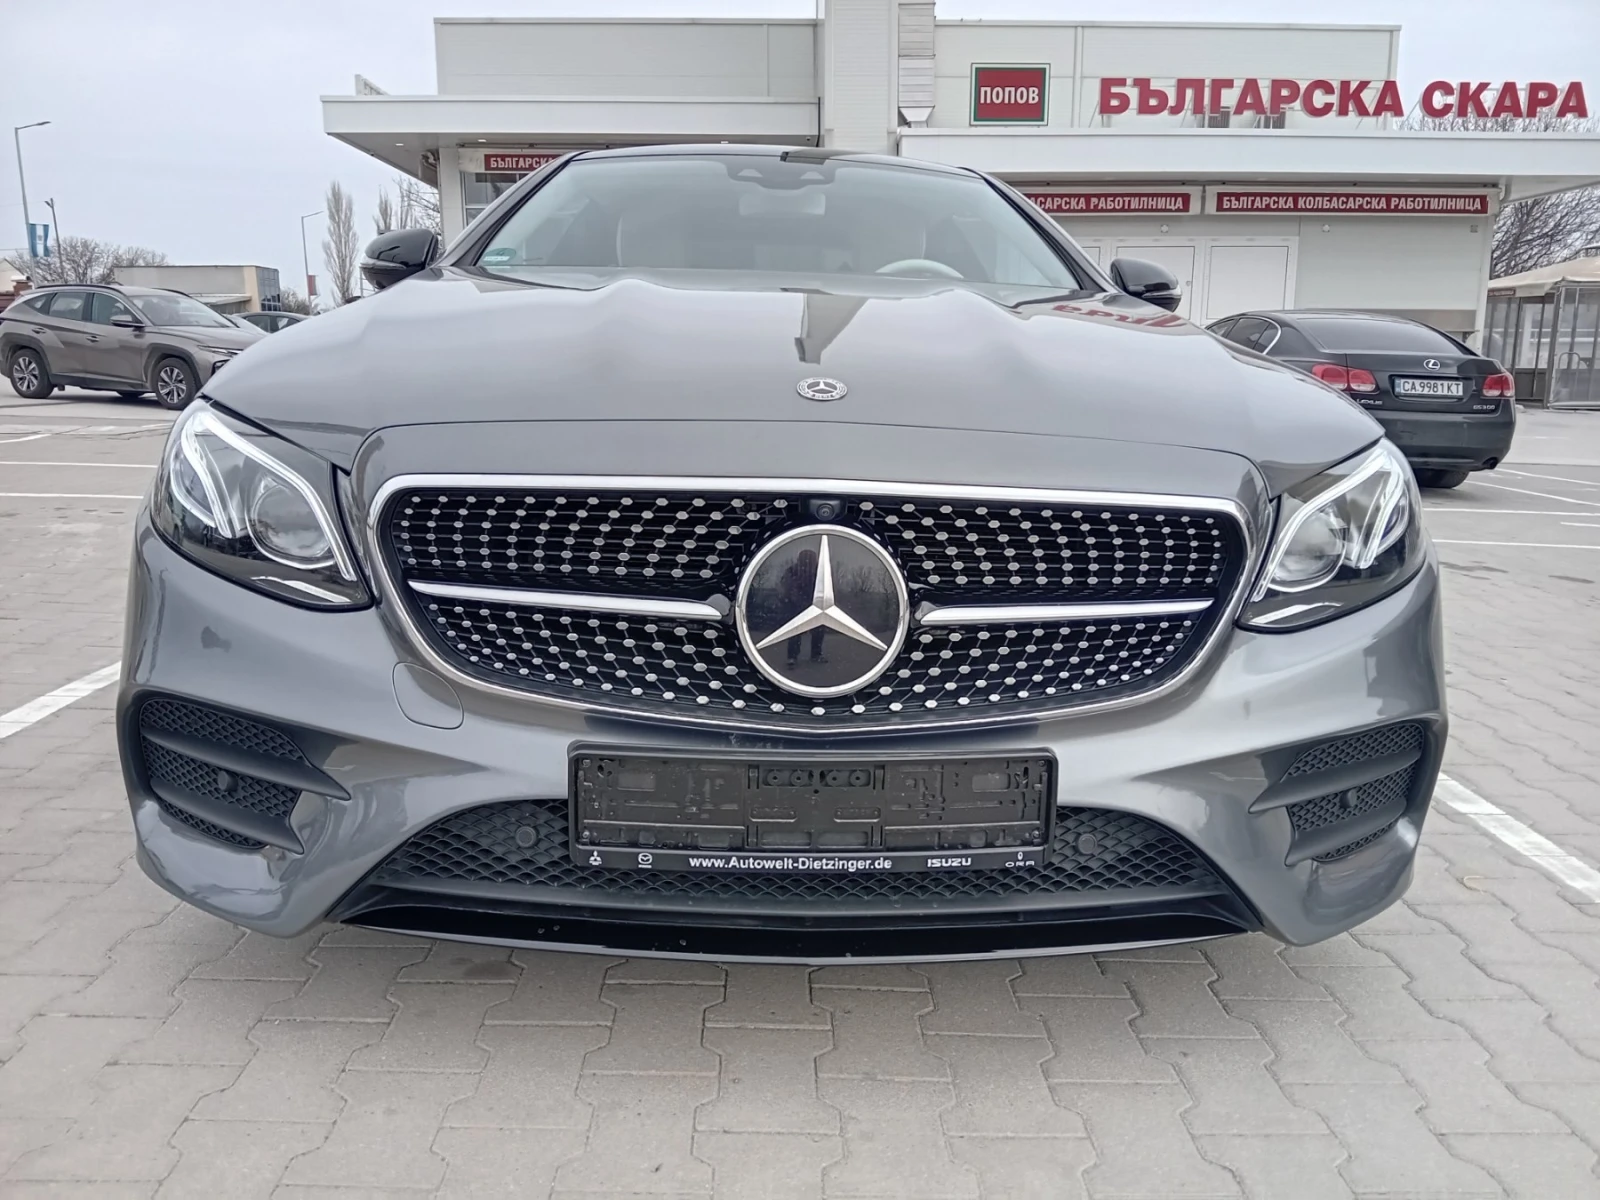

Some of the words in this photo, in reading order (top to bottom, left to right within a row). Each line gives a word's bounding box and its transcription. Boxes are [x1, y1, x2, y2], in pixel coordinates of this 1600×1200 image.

[979, 86, 1040, 104] ПОПОВ
[1099, 77, 1405, 118] БЪЛГАРСКА
[1420, 80, 1589, 118] СКАРА
[490, 157, 553, 168] БЪЛГАРСК
[1090, 196, 1184, 210] РАБОТИЛНИЦА
[1222, 195, 1294, 209] БЪЛГАРСКА
[1297, 196, 1387, 210] КОЛБАСАРСКА
[1390, 196, 1482, 211] РАБОТИЛНИЦА
[688, 856, 893, 872] www.Autowelt-Dietzinger.de
[927, 857, 972, 868] ISUZU
